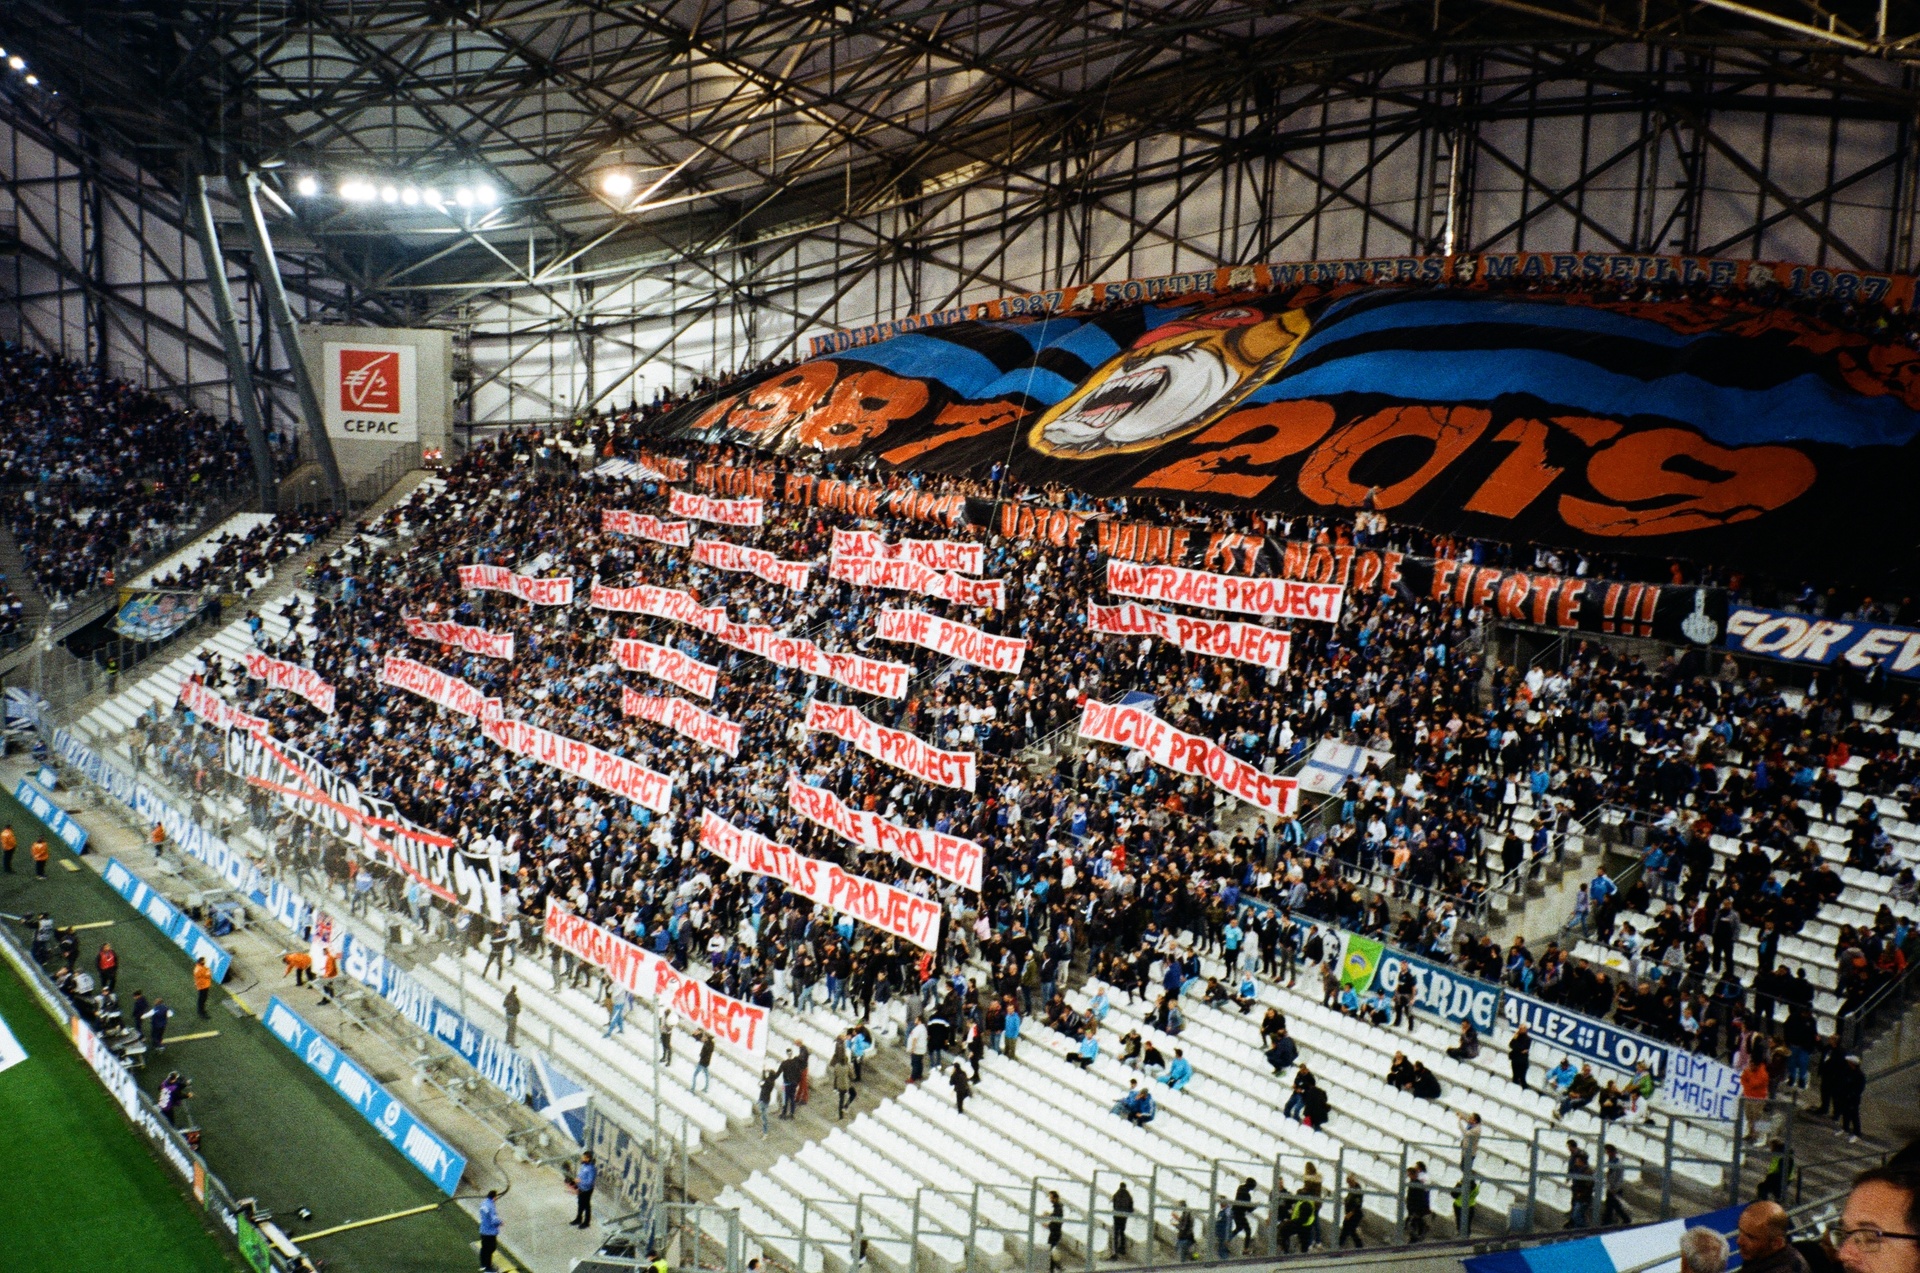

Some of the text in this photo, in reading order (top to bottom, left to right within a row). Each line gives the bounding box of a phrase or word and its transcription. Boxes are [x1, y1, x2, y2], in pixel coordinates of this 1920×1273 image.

[998, 291, 1065, 318] 1987
[1103, 271, 1218, 303] SOUTH
[1268, 257, 1446, 287] WINNERS
[1482, 254, 1740, 288] MARSEILLE
[1789, 266, 1893, 300] 1987
[344, 420, 398, 434] CEPAC
[1132, 400, 1817, 536] 2019
[515, 575, 571, 604] PRECT
[749, 550, 808, 591] PRECT
[936, 567, 1001, 608] OJECT
[1001, 503, 1085, 549] VOTRE
[1099, 521, 1191, 566] HAINE
[1204, 532, 1266, 577] EST
[1283, 540, 1404, 598] NOTRE
[1430, 559, 1587, 629] FIERTE
[1602, 582, 1661, 637] !!!
[1107, 562, 1341, 619] NAUFRAGE PROJECT
[937, 621, 1025, 672] PROJECT
[1176, 617, 1291, 667] PROJECT
[1727, 609, 1853, 661] FOR
[824, 653, 906, 697] PROJECT
[671, 701, 742, 753] PROJECT
[518, 723, 536, 756] DE
[541, 732, 557, 764] LA
[562, 741, 589, 774] LFP
[593, 752, 668, 808] PROJECT
[877, 728, 971, 788] PROJECT
[1168, 732, 1297, 815] PROJECT
[872, 815, 979, 886] PROJECT
[828, 866, 939, 944] PROJECT
[344, 937, 385, 994] 84
[654, 960, 764, 1051] PROJECT
[1504, 997, 1661, 1077] ALLEZ L'OM
[1675, 1053, 1707, 1083] OM
[1672, 1079, 1732, 1120] MAGIC
